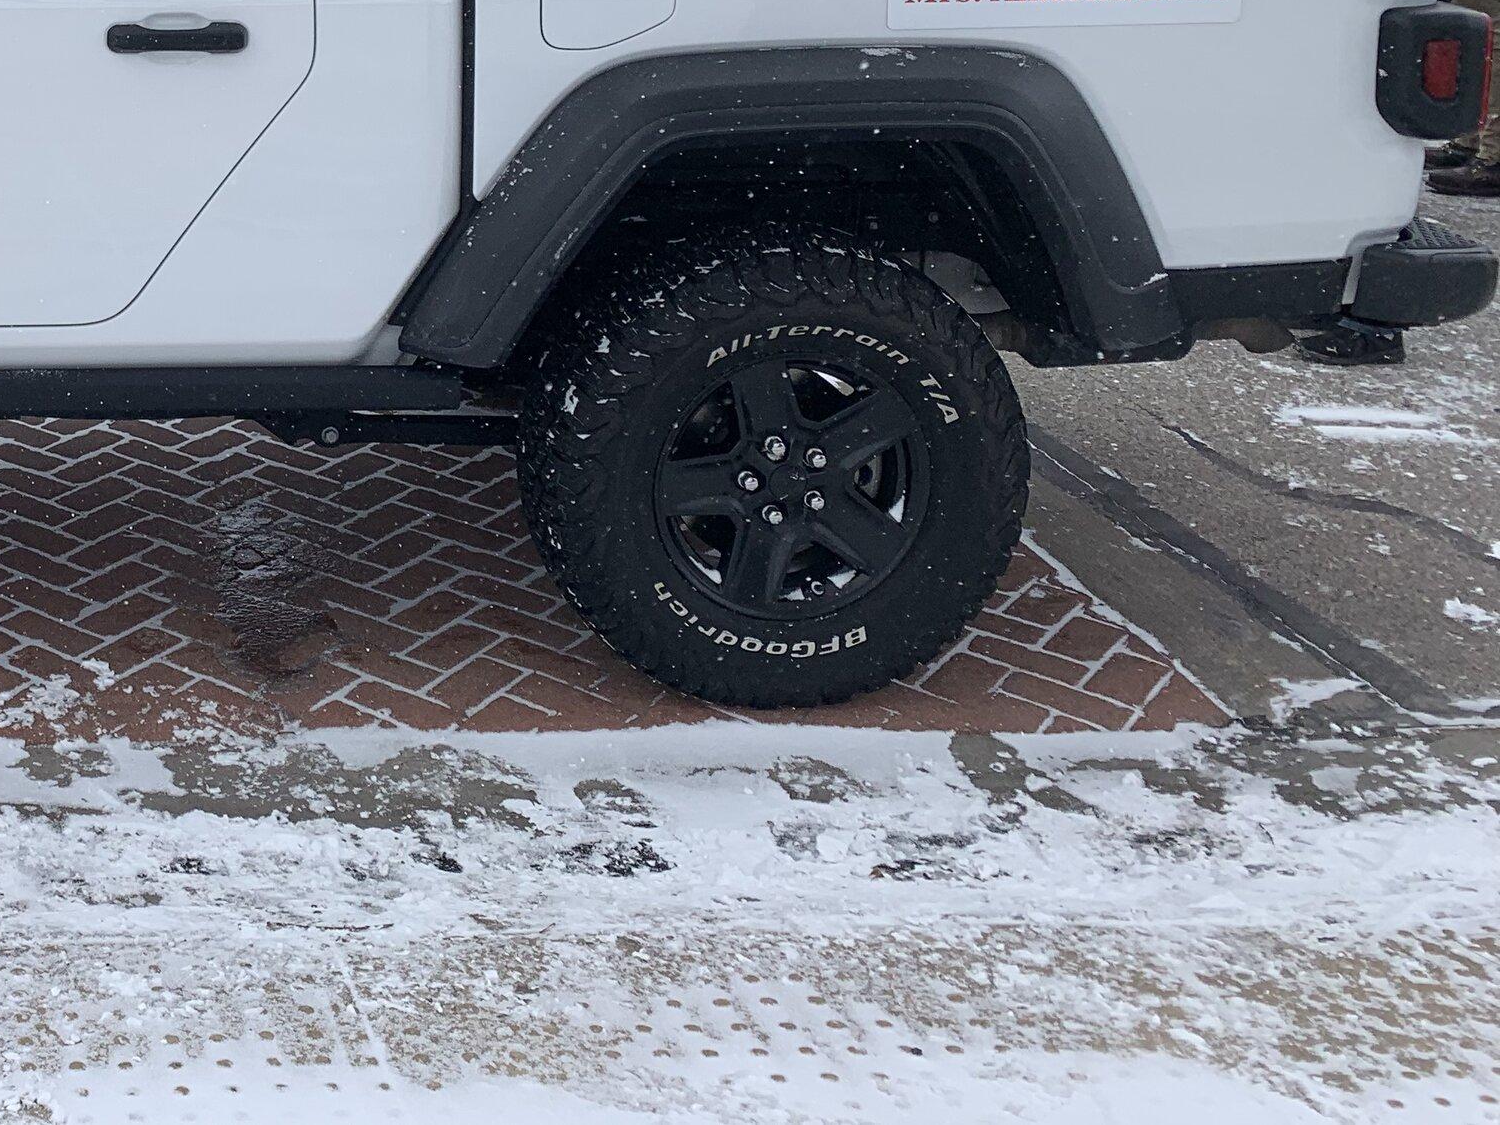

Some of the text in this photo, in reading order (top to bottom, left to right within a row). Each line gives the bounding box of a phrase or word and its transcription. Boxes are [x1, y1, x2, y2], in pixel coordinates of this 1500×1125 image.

[706, 325, 960, 425] All-Terrain T/A
[653, 581, 868, 658] BFGoodrich
